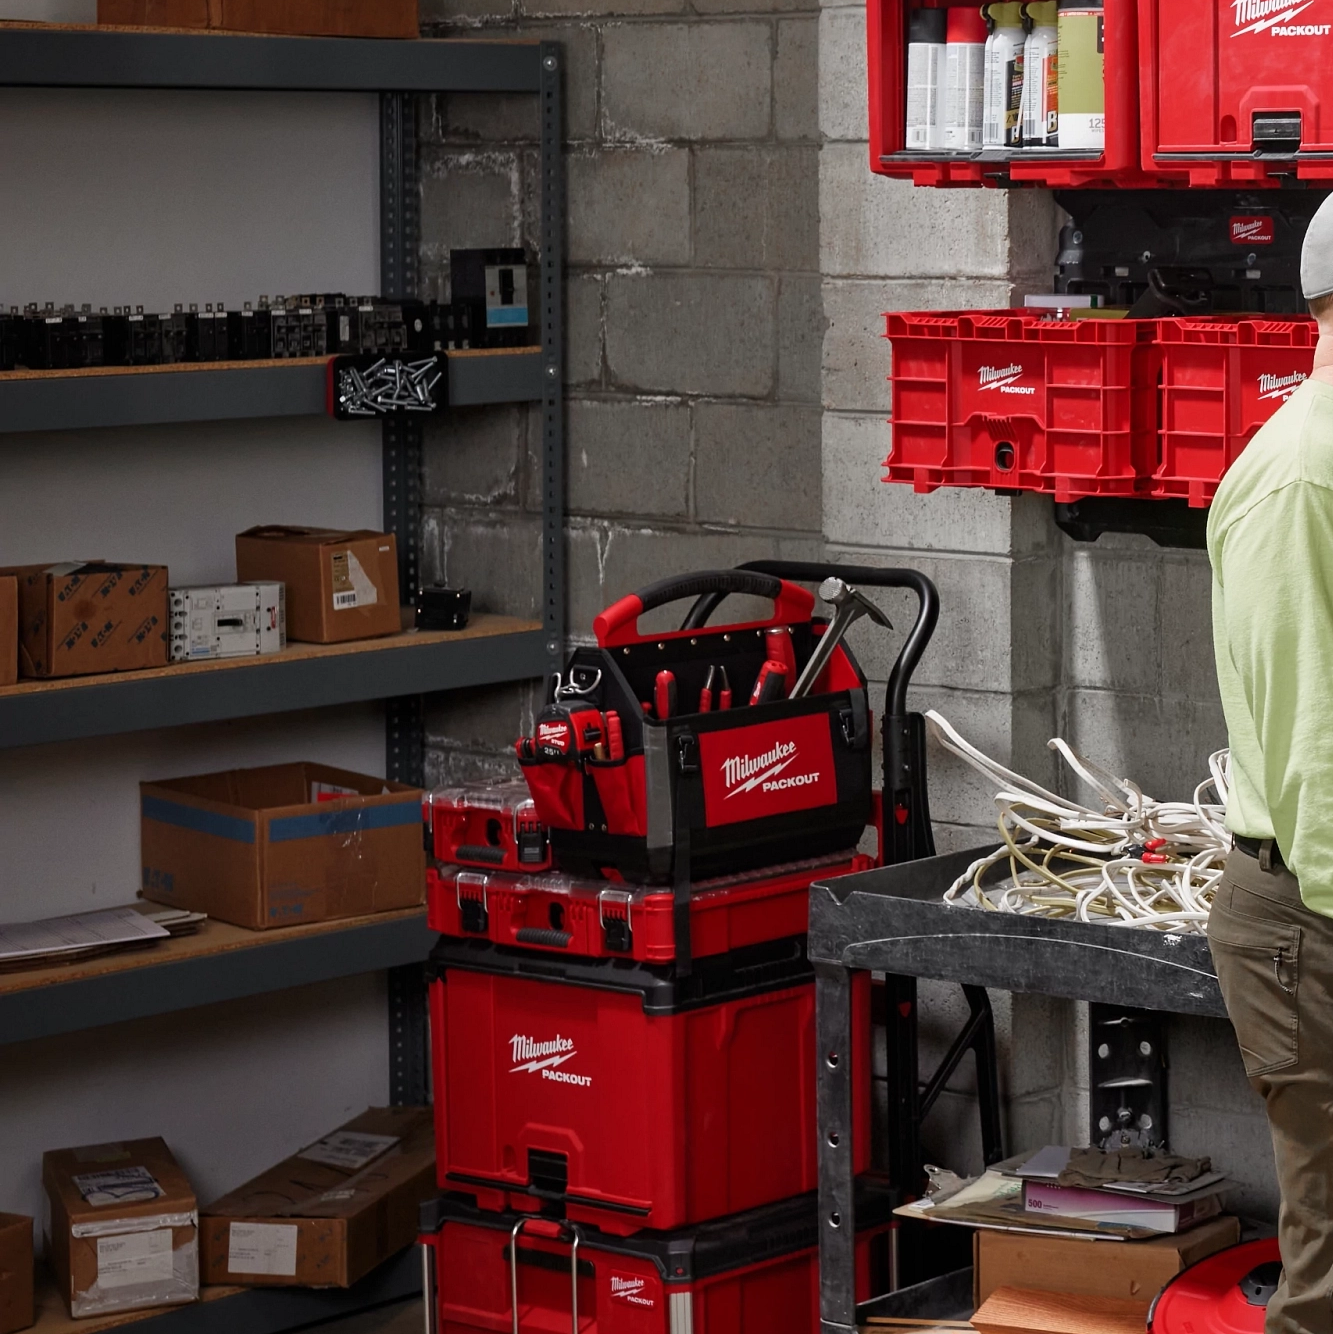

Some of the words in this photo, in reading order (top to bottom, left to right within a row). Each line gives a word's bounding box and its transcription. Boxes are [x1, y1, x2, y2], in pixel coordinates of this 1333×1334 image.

[1271, 25, 1331, 37] PACKOUT
[1231, 220, 1264, 236] Milwaukee
[978, 363, 1022, 385] Milwaukee
[1257, 371, 1307, 393] Milwaukee
[1000, 386, 1035, 395] PACKOUT
[539, 723, 567, 736] Milwaukee
[721, 740, 797, 787] Milwaukee
[762, 772, 820, 793] PACKOUT
[509, 1034, 574, 1062] Milwaukee
[542, 1069, 592, 1087] PACKOUT
[1028, 1198, 1042, 1209] 500
[611, 1276, 644, 1293] Milwaukee
[627, 1296, 654, 1306] PACKOUT
